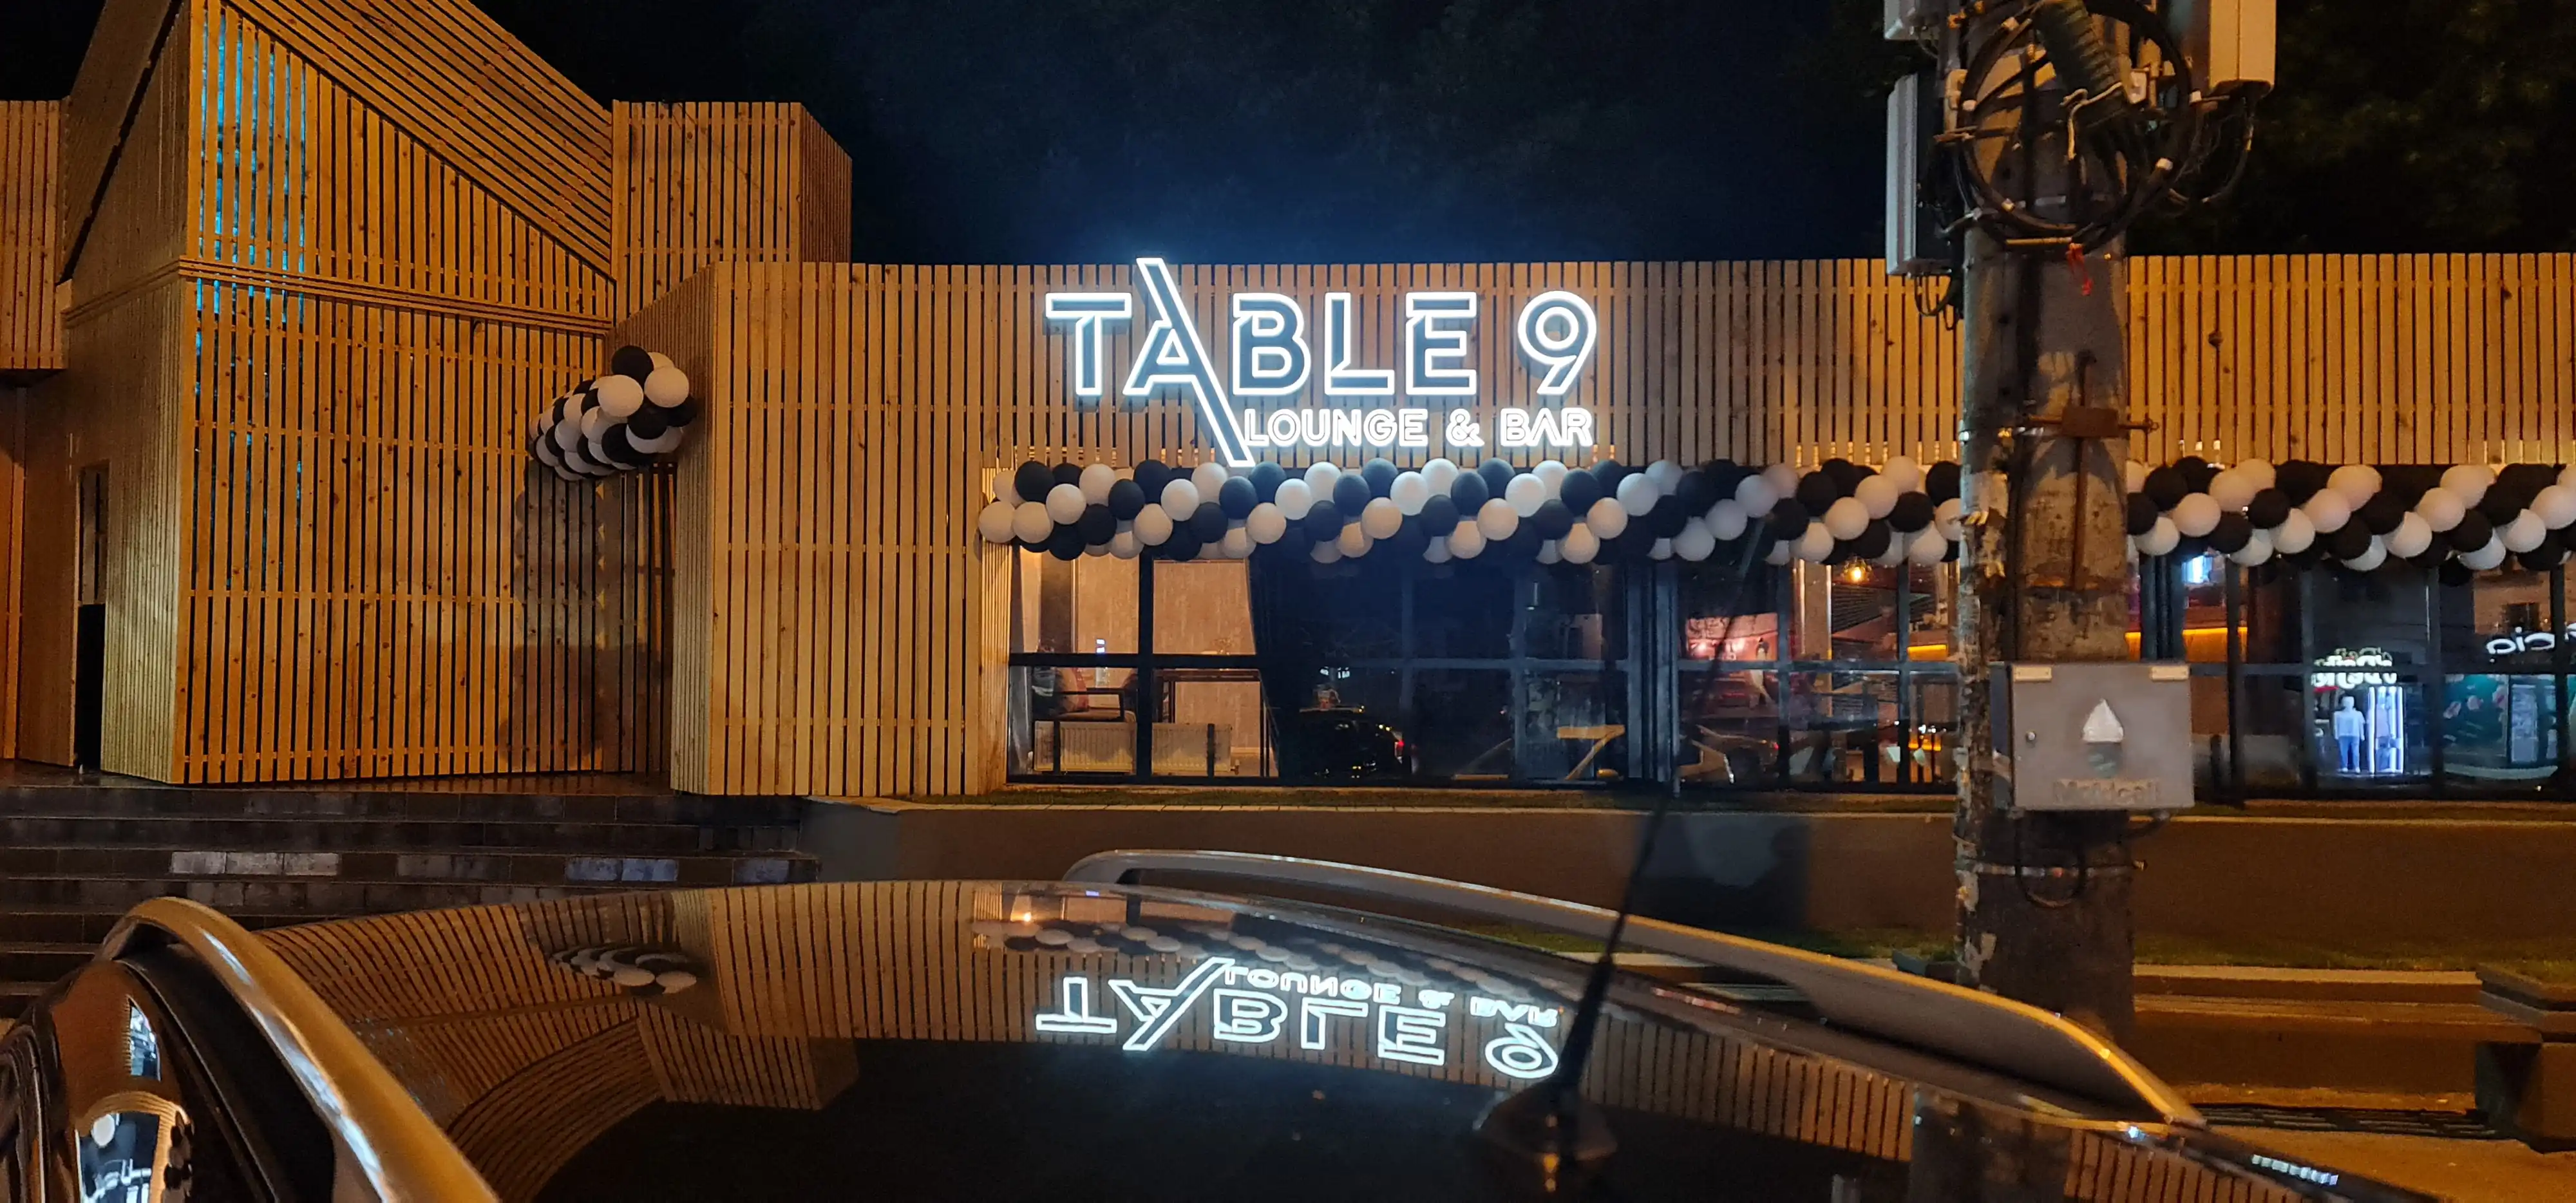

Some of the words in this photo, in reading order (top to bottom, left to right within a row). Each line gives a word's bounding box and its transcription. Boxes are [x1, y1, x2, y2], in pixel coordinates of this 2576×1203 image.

[1045, 258, 1477, 468] TABLE
[1517, 290, 1597, 395] 9
[1244, 407, 1429, 447] LOUNGE
[1446, 407, 1485, 448] &
[1500, 407, 1593, 448] BAR
